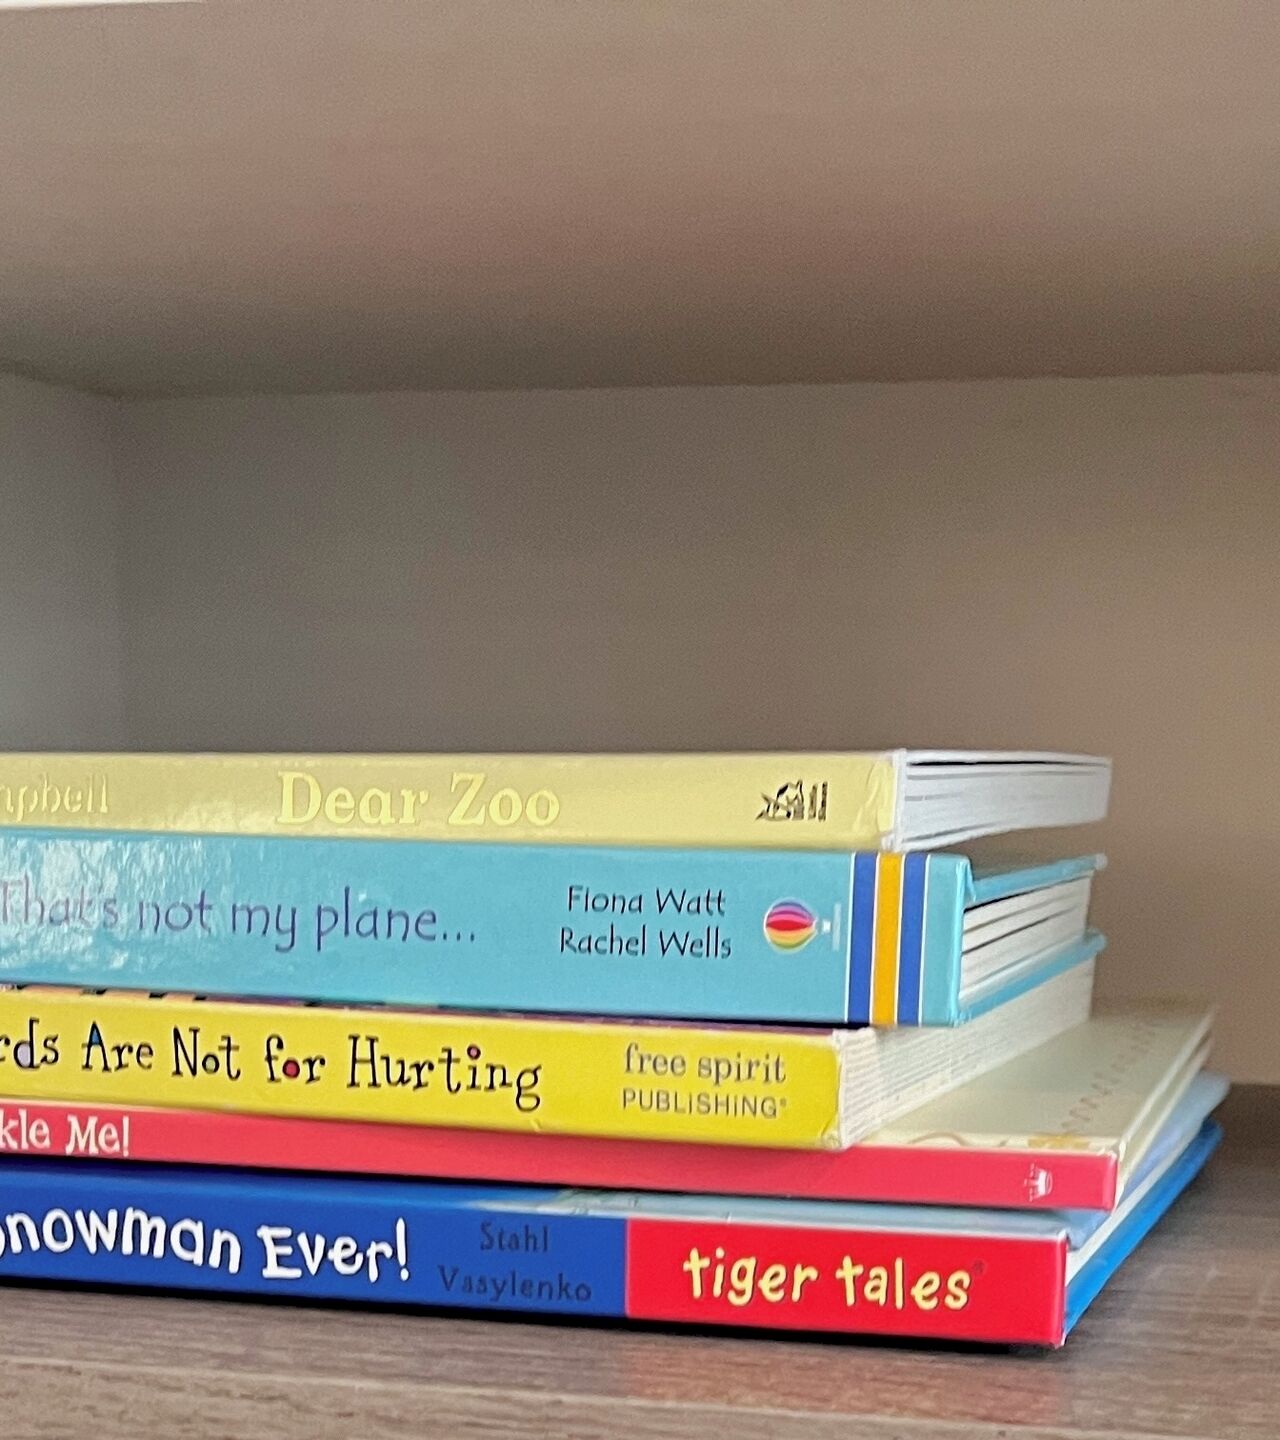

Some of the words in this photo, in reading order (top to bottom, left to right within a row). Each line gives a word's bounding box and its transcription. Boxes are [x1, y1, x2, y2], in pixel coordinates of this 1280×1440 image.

[276, 770, 429, 826] Dear
[448, 772, 561, 828] Zoo
[136, 889, 214, 934] not
[230, 897, 298, 953] my
[314, 886, 477, 945] plane...
[566, 885, 644, 916] Fiona
[656, 887, 726, 918] Watt
[558, 925, 648, 958] Rachel
[659, 927, 733, 960] Wells
[80, 1020, 155, 1072] Are
[170, 1025, 242, 1082] Not
[263, 1033, 327, 1084] for
[346, 1034, 543, 1113] Hurting
[624, 1041, 687, 1077] free
[697, 1051, 787, 1087] spirit
[65, 1114, 131, 1157] Me!
[257, 1217, 411, 1284] Ever!
[478, 1218, 552, 1254] Stahl
[437, 1264, 593, 1304] Vasylenko
[682, 1245, 819, 1307] tiger
[836, 1253, 972, 1312] tales
